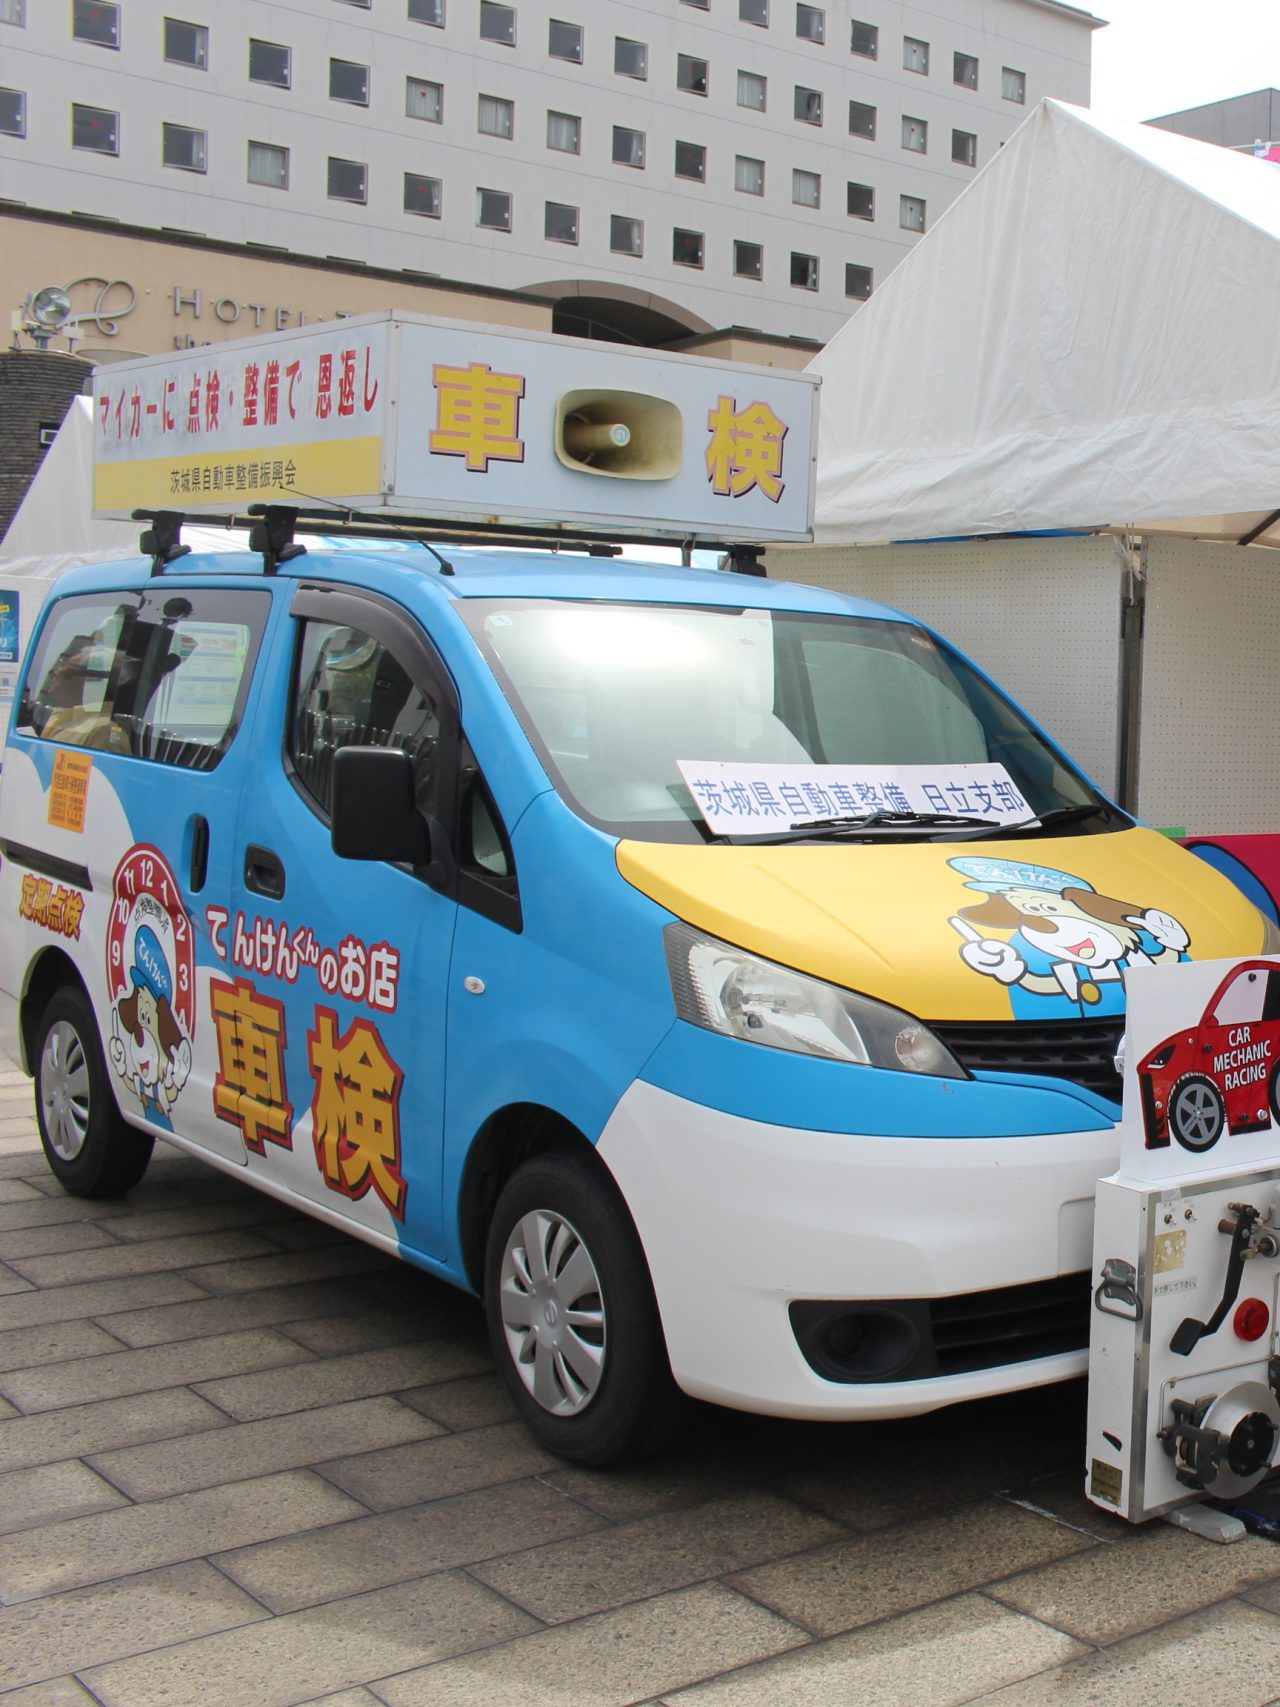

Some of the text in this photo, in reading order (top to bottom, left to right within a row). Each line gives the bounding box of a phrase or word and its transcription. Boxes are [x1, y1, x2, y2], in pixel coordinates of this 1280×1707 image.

[99, 345, 380, 441] マイカーに 点検・整備で 恩返し
[169, 458, 298, 495] 茨城県自動車整備振興会
[692, 778, 1026, 818] 茨城県自動車整備 日立支部
[124, 868, 136, 895] 11
[140, 858, 154, 888] 12
[19, 873, 85, 942] 定期点検
[117, 897, 130, 925] 10
[175, 913, 187, 942] 2
[112, 940, 121, 967] 9
[205, 904, 401, 1015] てんけんくんのお店
[179, 963, 189, 991] 3
[1228, 1026, 1251, 1047] CAR
[1213, 1039, 1272, 1074] MECHANIC
[1225, 1062, 1267, 1091] RACING
[209, 977, 409, 1224] 車検
